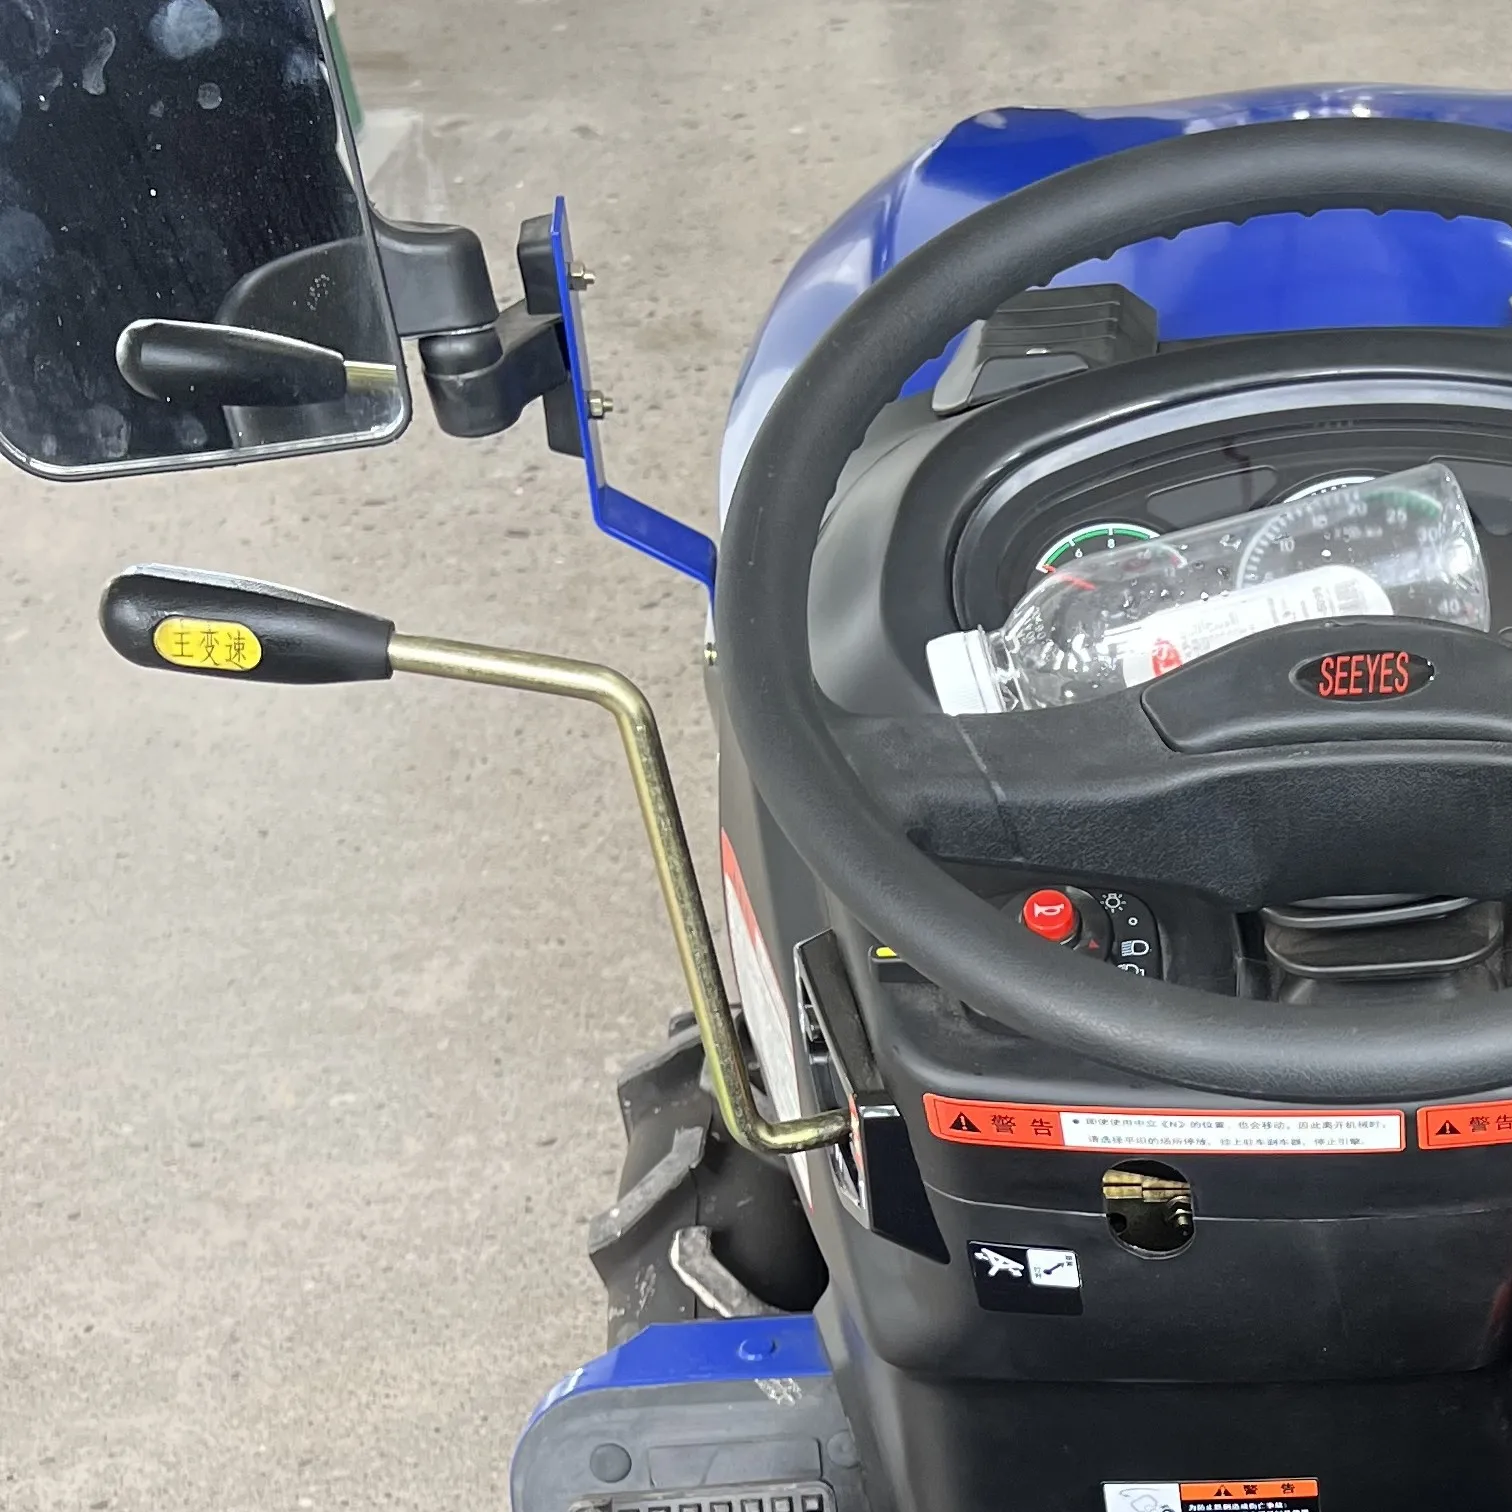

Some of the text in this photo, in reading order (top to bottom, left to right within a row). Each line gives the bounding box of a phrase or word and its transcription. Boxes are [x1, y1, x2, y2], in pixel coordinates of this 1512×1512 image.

[1108, 538, 1116, 549] 8
[1075, 548, 1083, 558] 6
[1318, 651, 1409, 698] SEEYES
[989, 1113, 1055, 1137] 警告
[1242, 1482, 1296, 1496] 警告
